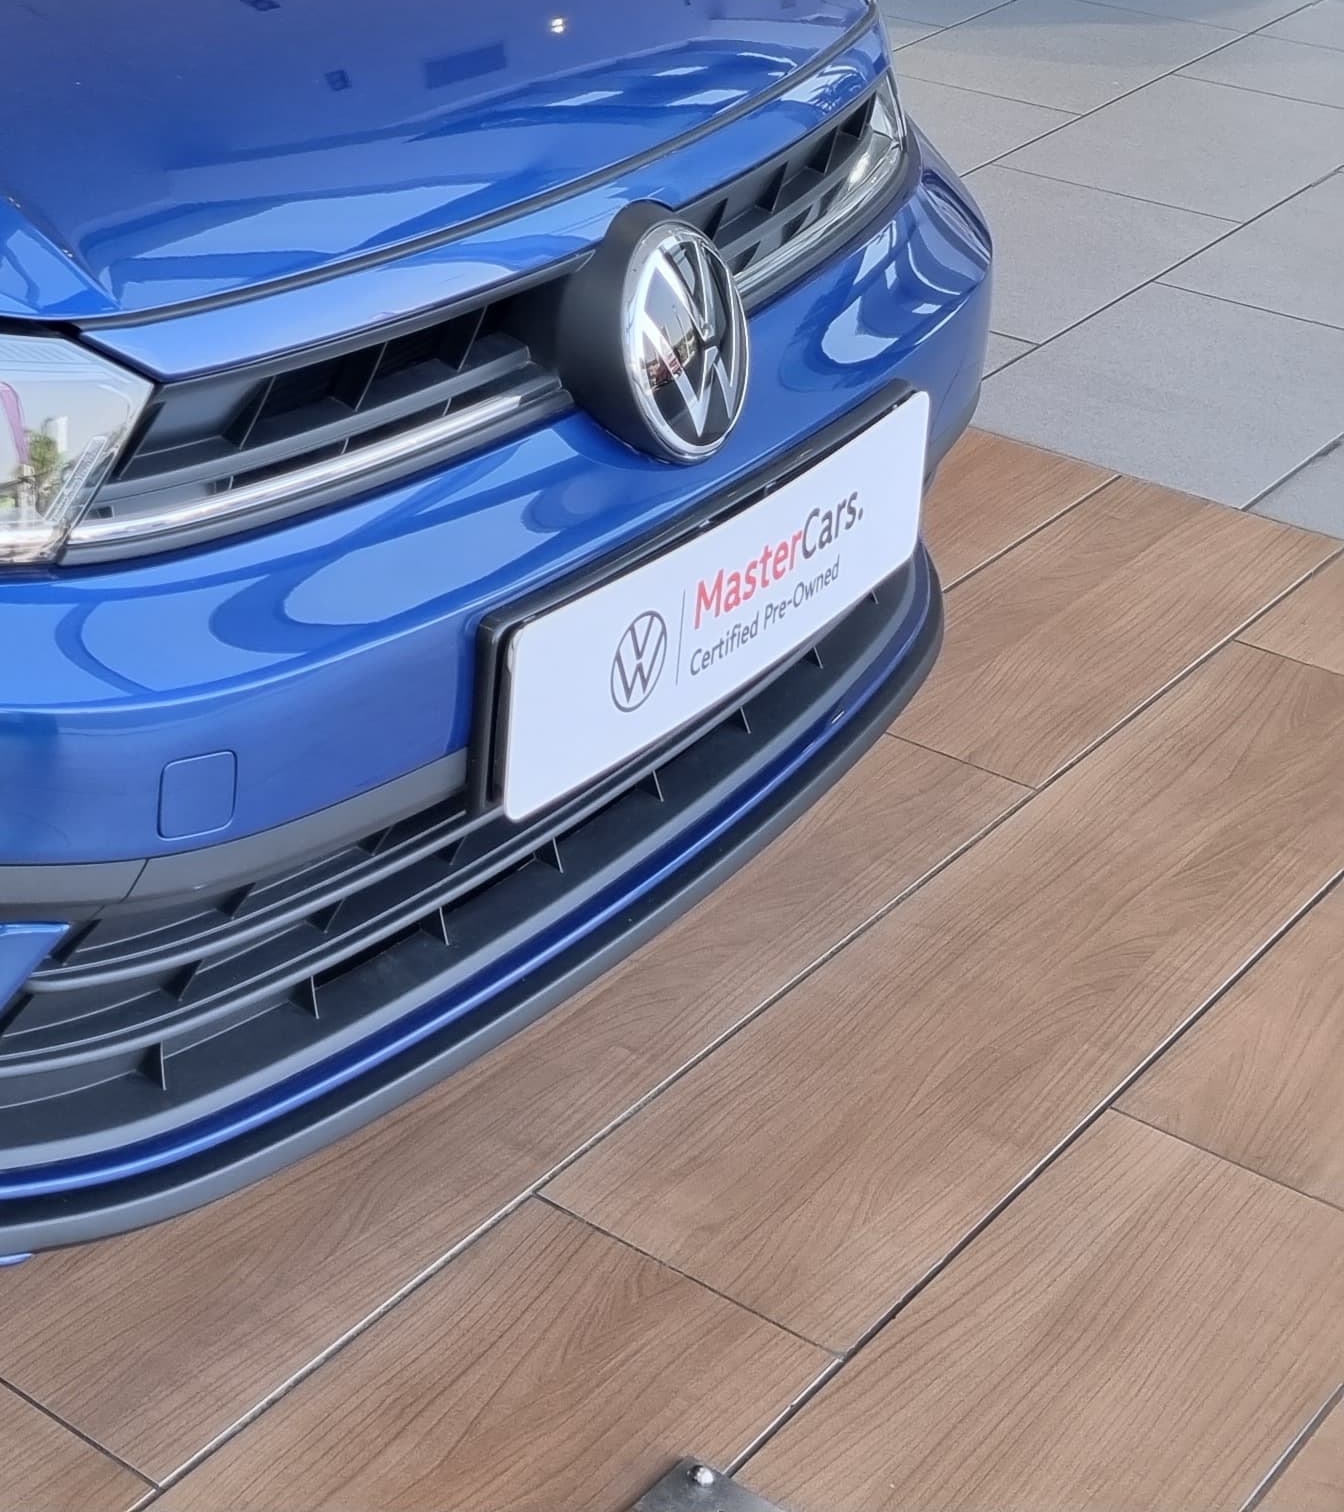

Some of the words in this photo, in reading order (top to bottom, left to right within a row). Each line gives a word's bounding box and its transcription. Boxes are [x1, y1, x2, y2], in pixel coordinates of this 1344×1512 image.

[690, 610, 760, 676] Certified
[763, 554, 841, 630] Pre-Owned
[694, 491, 864, 630] MasterCars.
